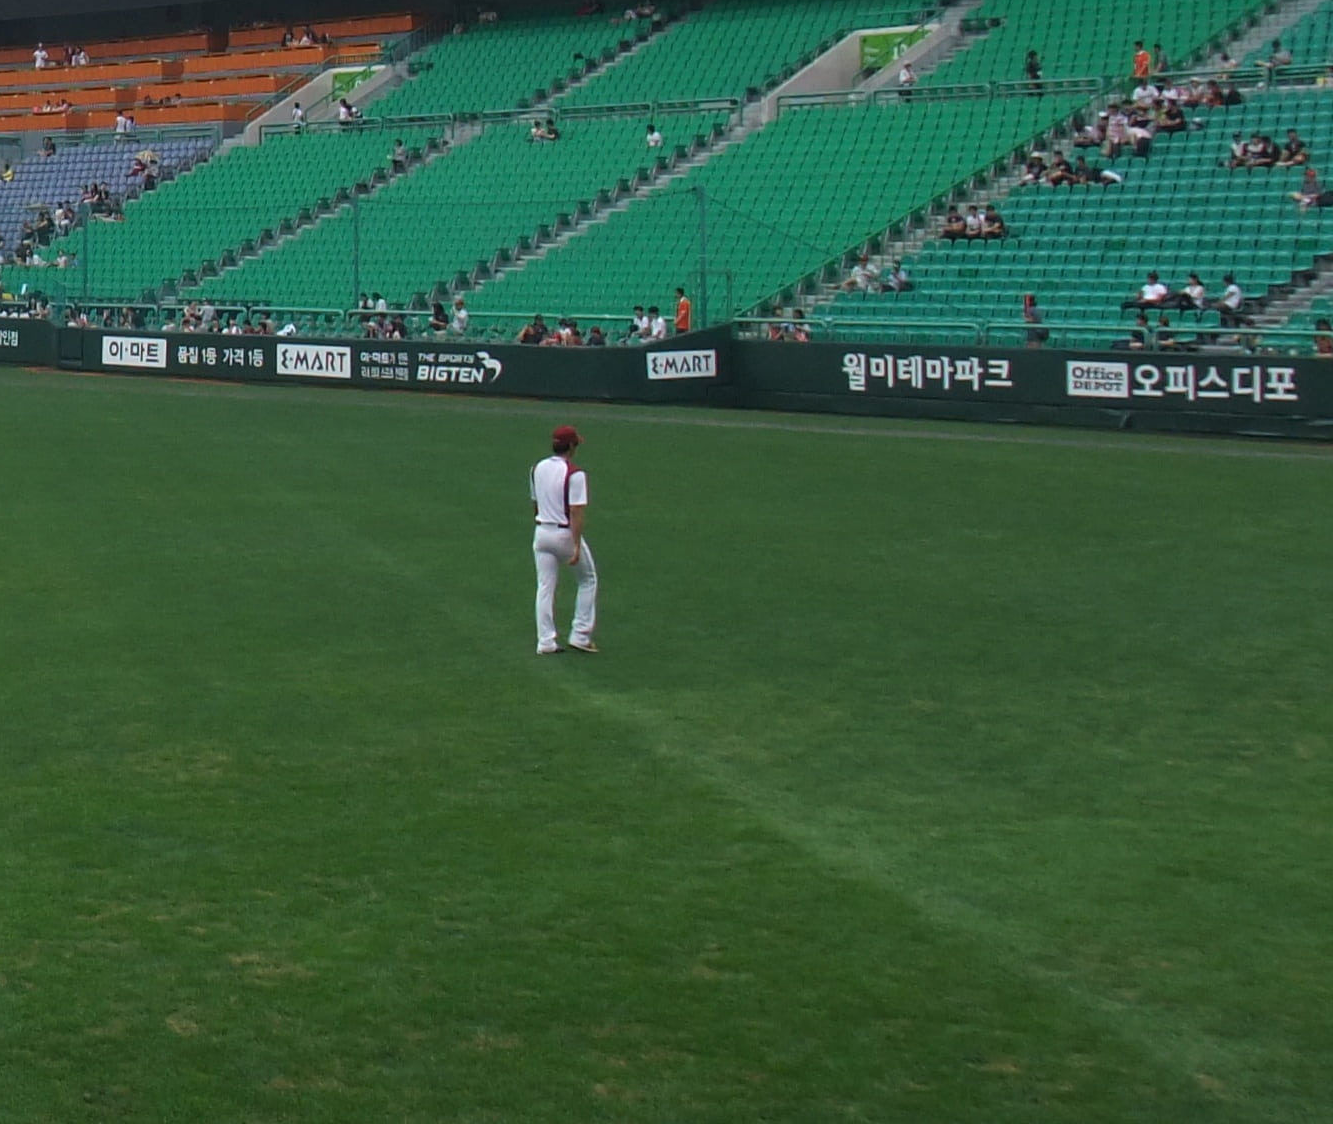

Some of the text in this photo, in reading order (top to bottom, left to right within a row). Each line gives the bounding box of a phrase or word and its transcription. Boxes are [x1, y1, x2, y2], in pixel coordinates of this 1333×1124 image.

[222, 348, 245, 367] 가격
[416, 364, 486, 384] BIGTEN
[841, 352, 1015, 392] 월미테마파크
[1071, 365, 1124, 381] Office
[1071, 380, 1124, 393] DEPOT
[1132, 363, 1299, 404] 오피스디포
